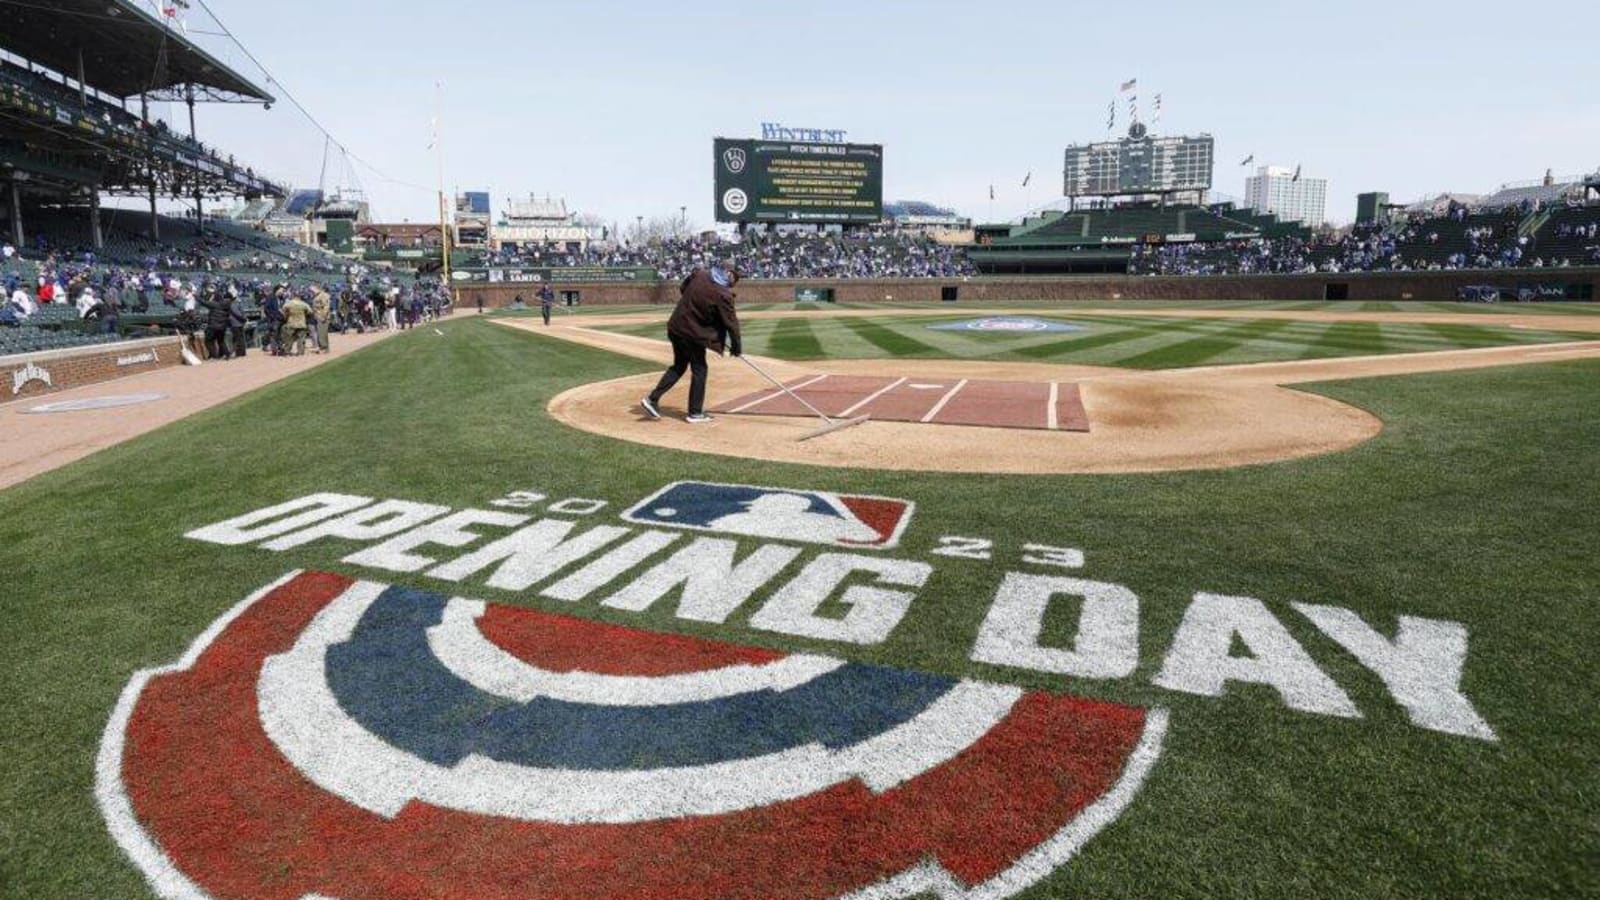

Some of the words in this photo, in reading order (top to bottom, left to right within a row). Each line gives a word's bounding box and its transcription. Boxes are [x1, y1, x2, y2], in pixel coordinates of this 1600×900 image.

[761, 122, 847, 143] WINTRUST
[184, 492, 932, 643] OPENING
[971, 572, 1498, 741] DAY
